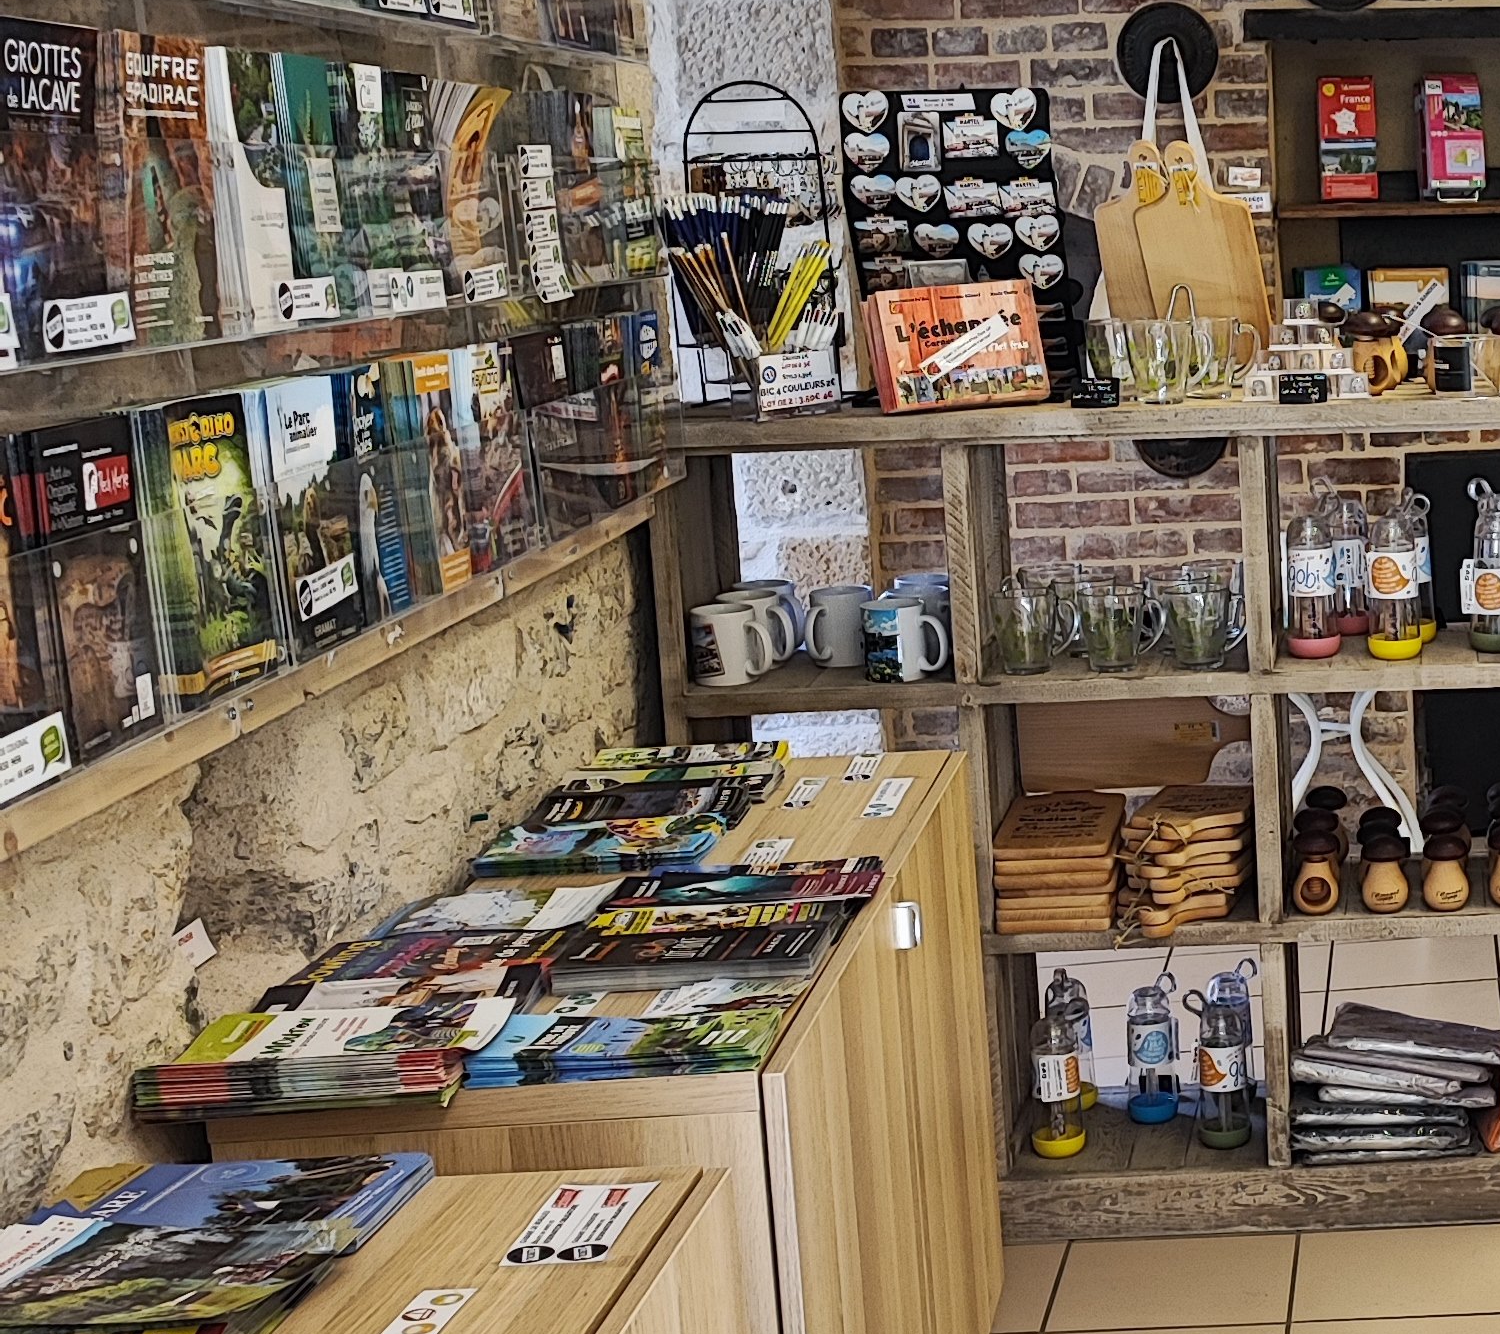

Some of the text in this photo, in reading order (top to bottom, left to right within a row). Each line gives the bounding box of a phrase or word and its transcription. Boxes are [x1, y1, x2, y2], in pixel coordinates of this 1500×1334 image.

[4, 38, 82, 79] GROTTES
[125, 51, 200, 81] GOUFFRE
[7, 76, 81, 113] de LACAVE
[1340, 95, 1371, 105] France
[760, 387, 775, 396] BIC
[782, 380, 826, 395] COULEURS
[761, 398, 776, 409] LOT
[200, 411, 235, 441] DINO
[292, 410, 311, 430] Parc
[1289, 561, 1320, 593] gobi
